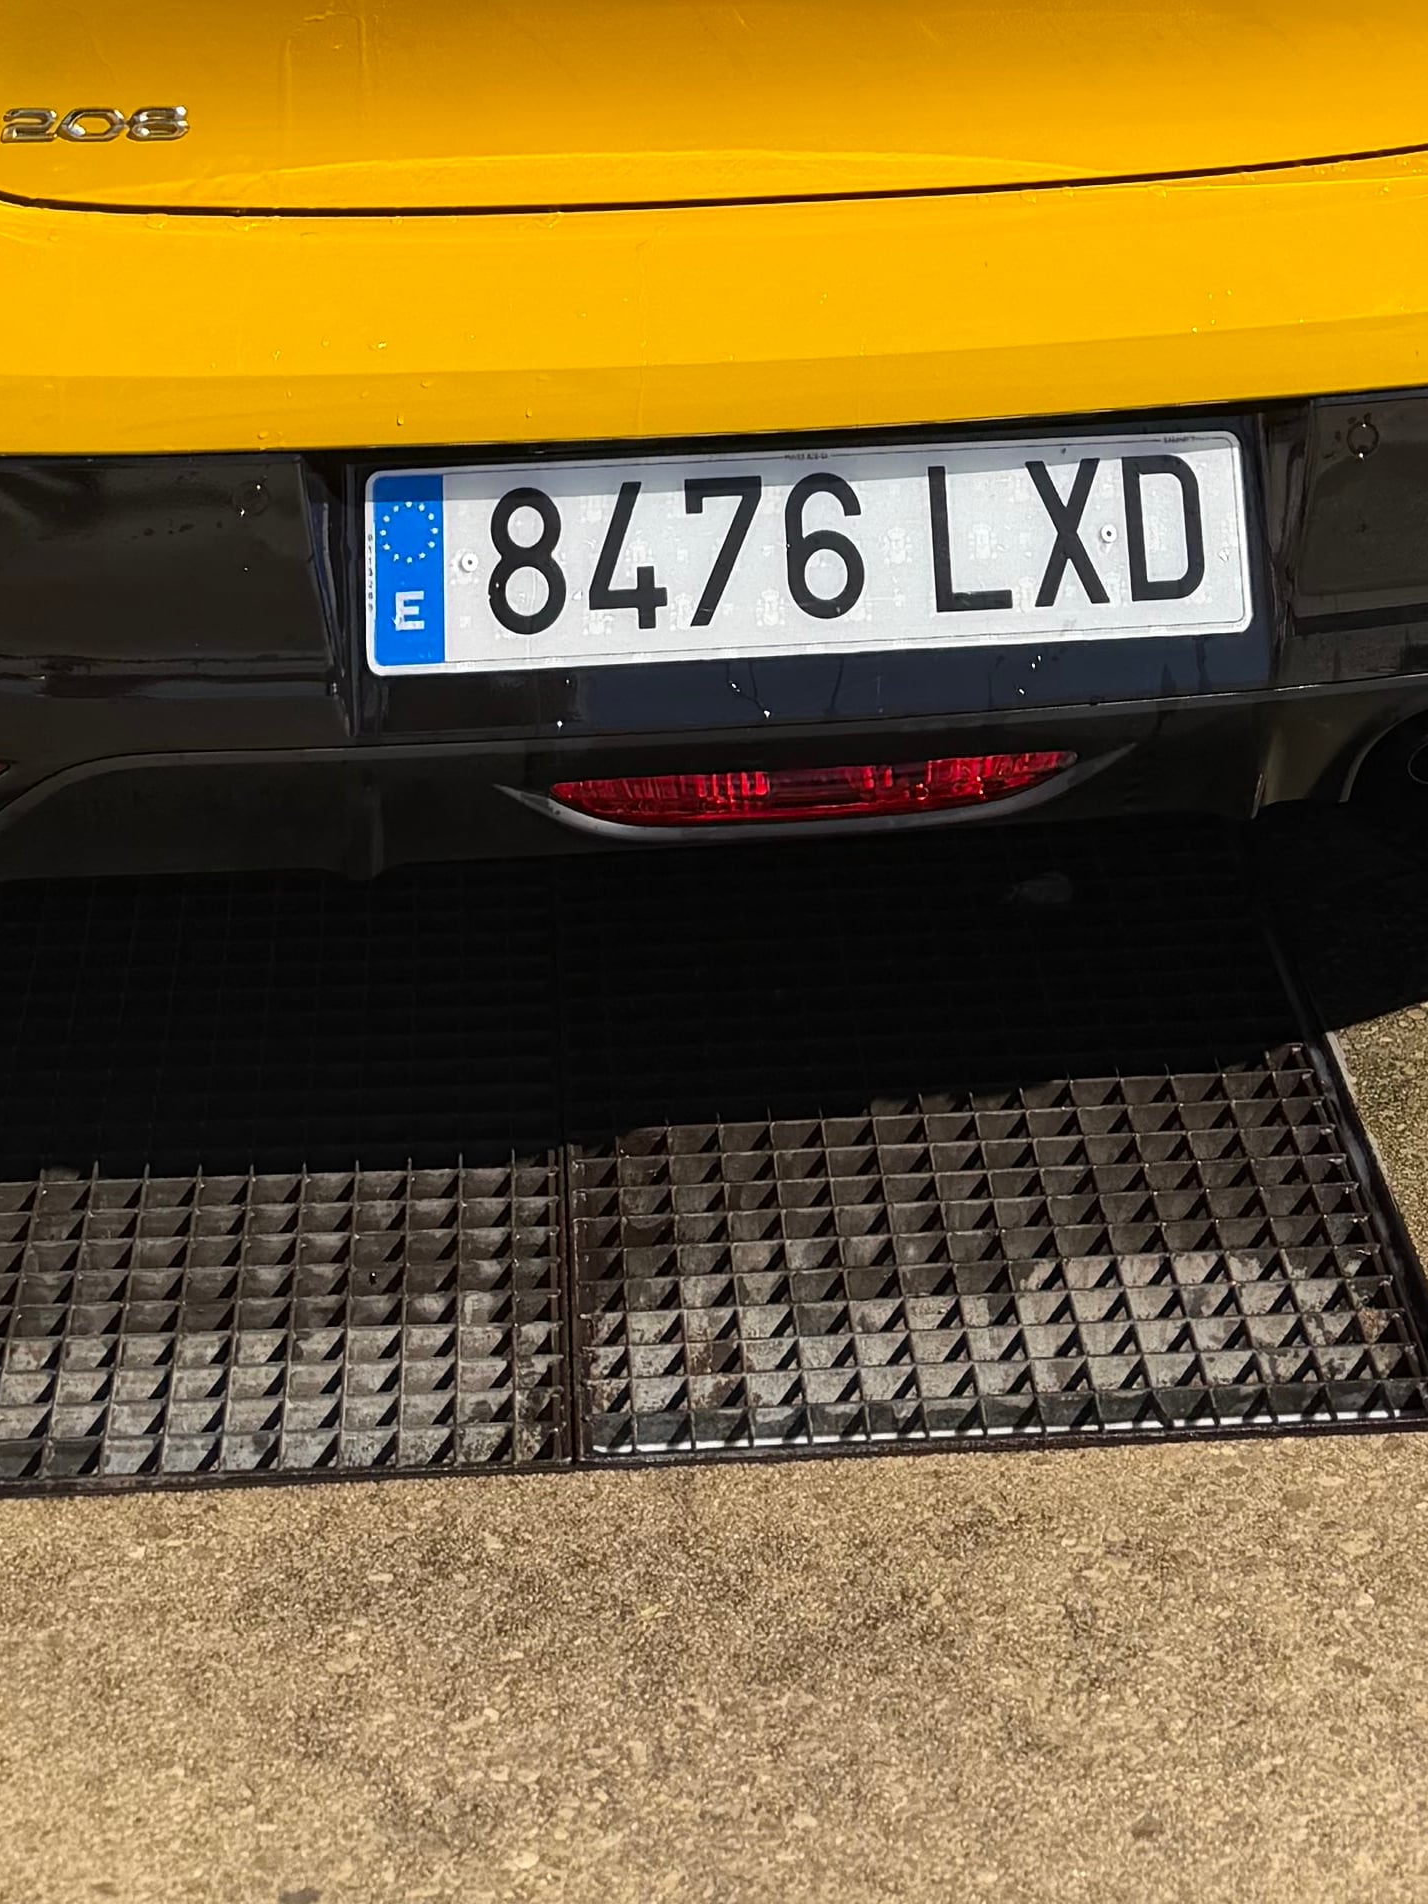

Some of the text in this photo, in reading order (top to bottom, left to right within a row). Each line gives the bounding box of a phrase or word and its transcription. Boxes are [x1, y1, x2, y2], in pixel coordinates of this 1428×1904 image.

[0, 104, 190, 143] 208
[487, 471, 866, 636] 8476
[926, 454, 1203, 613] LXD
[395, 590, 425, 631] E
